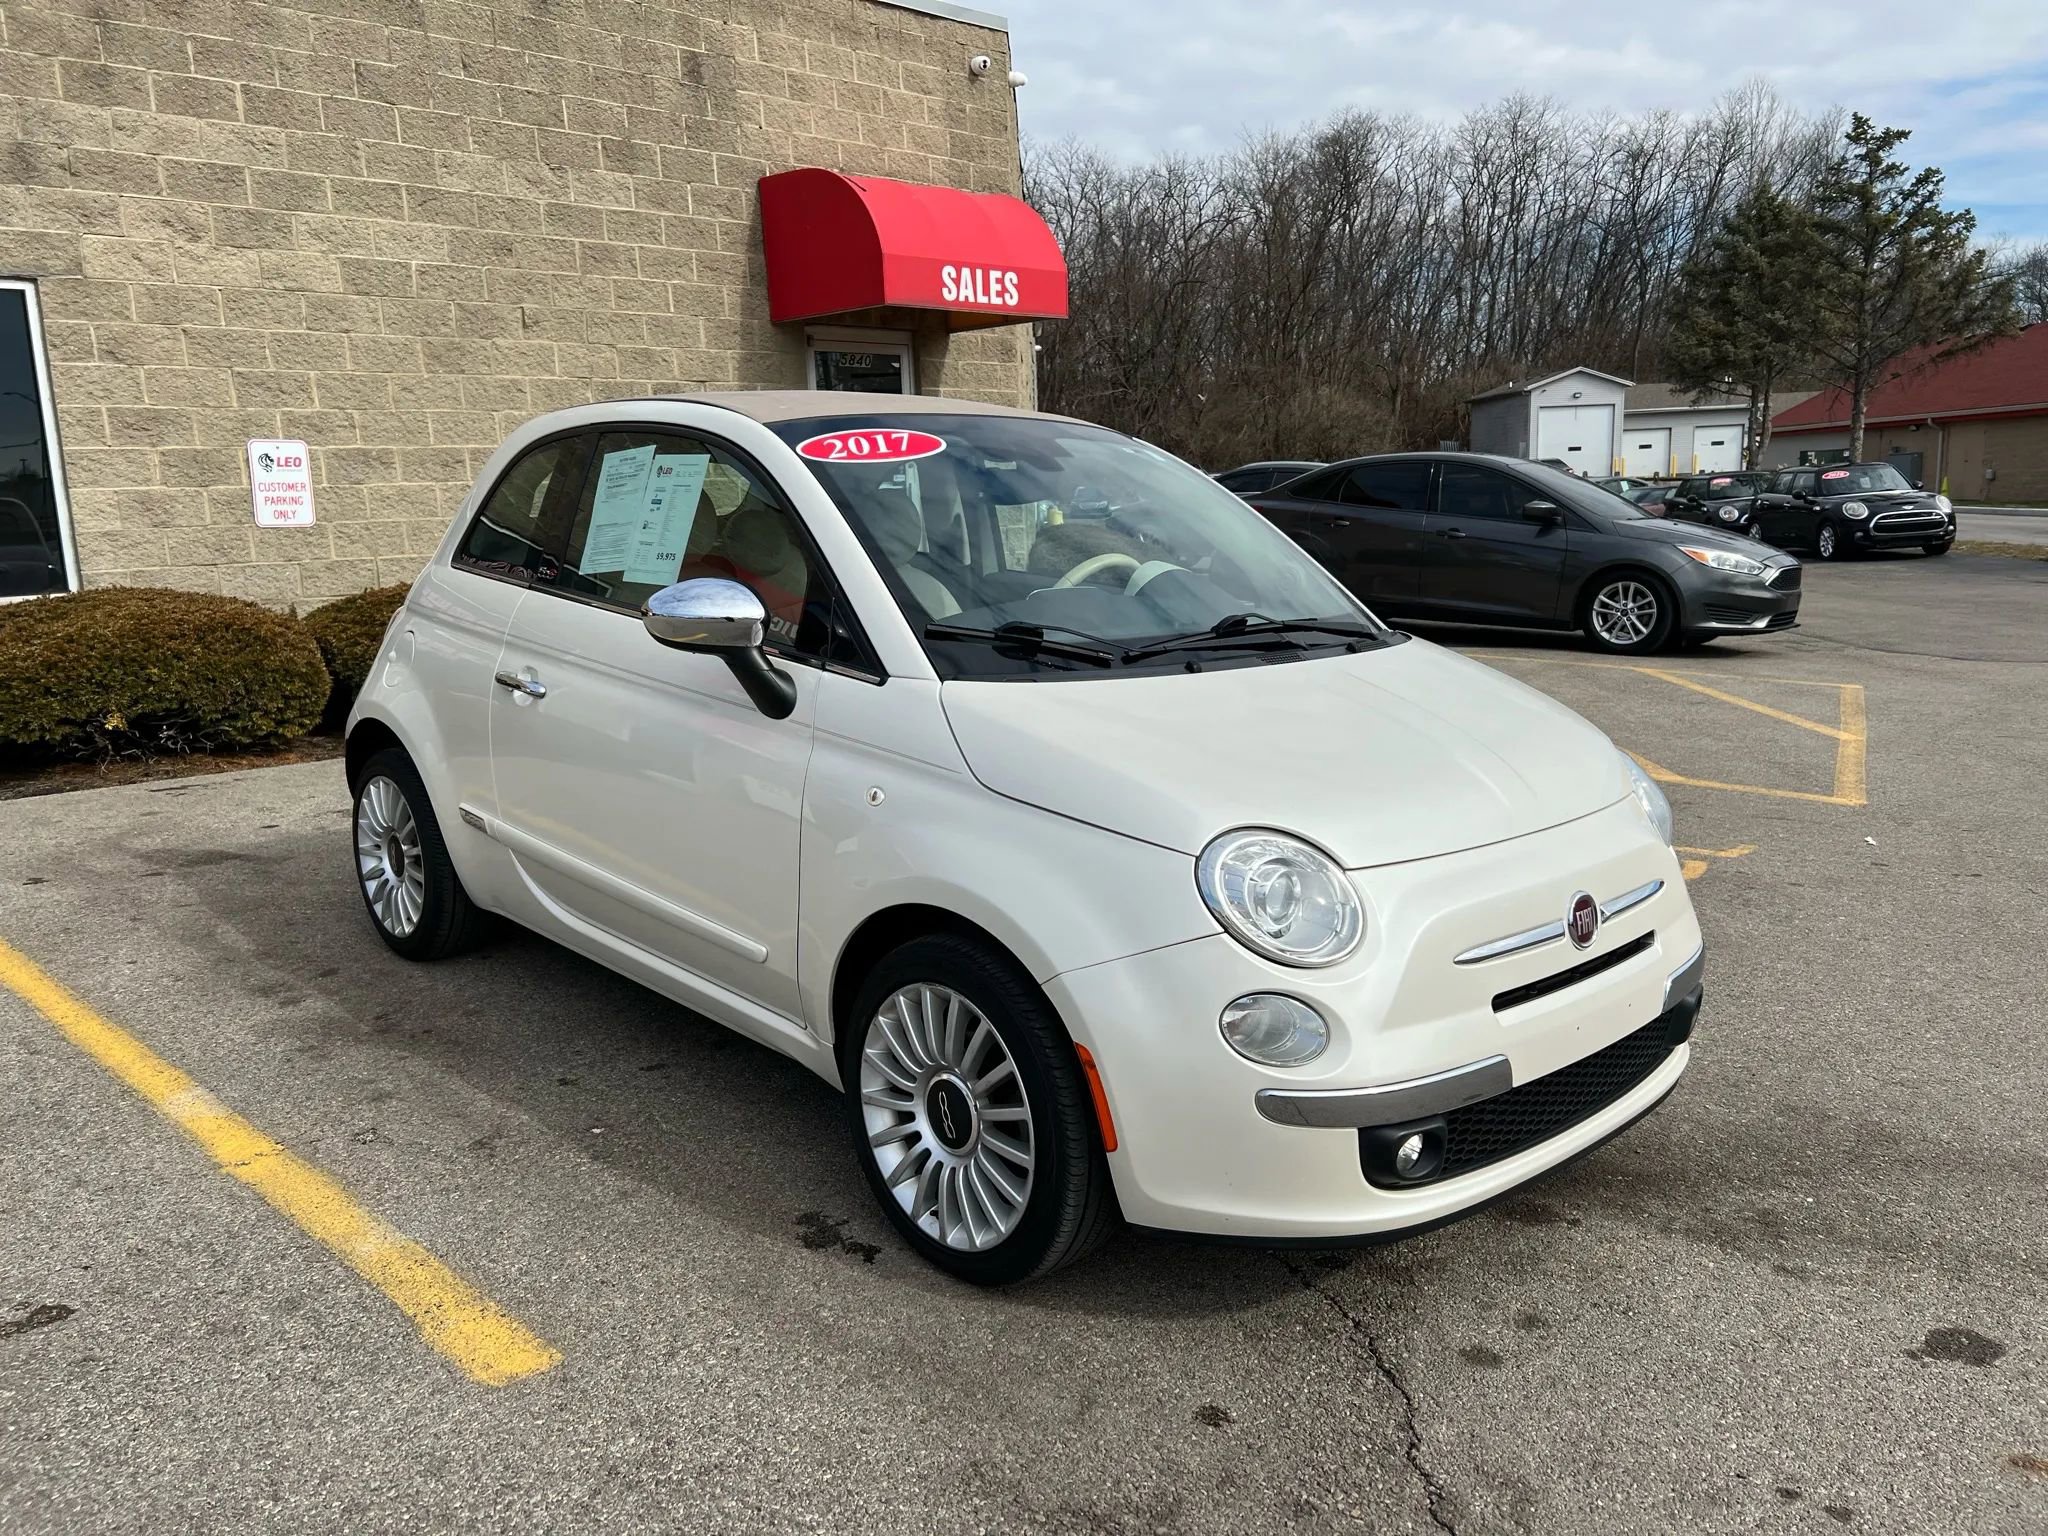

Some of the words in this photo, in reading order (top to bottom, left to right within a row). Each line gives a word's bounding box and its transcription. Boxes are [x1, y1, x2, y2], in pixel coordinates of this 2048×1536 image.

[941, 265, 1019, 306] SALES
[840, 353, 872, 368] 5840
[823, 432, 910, 459] 2017
[276, 456, 302, 467] LEO
[258, 482, 307, 493] CUSTOMER
[264, 495, 304, 506] PARKING
[273, 509, 297, 520] ONLY
[656, 552, 676, 561] $9,975
[1575, 906, 1594, 935] FIAT
